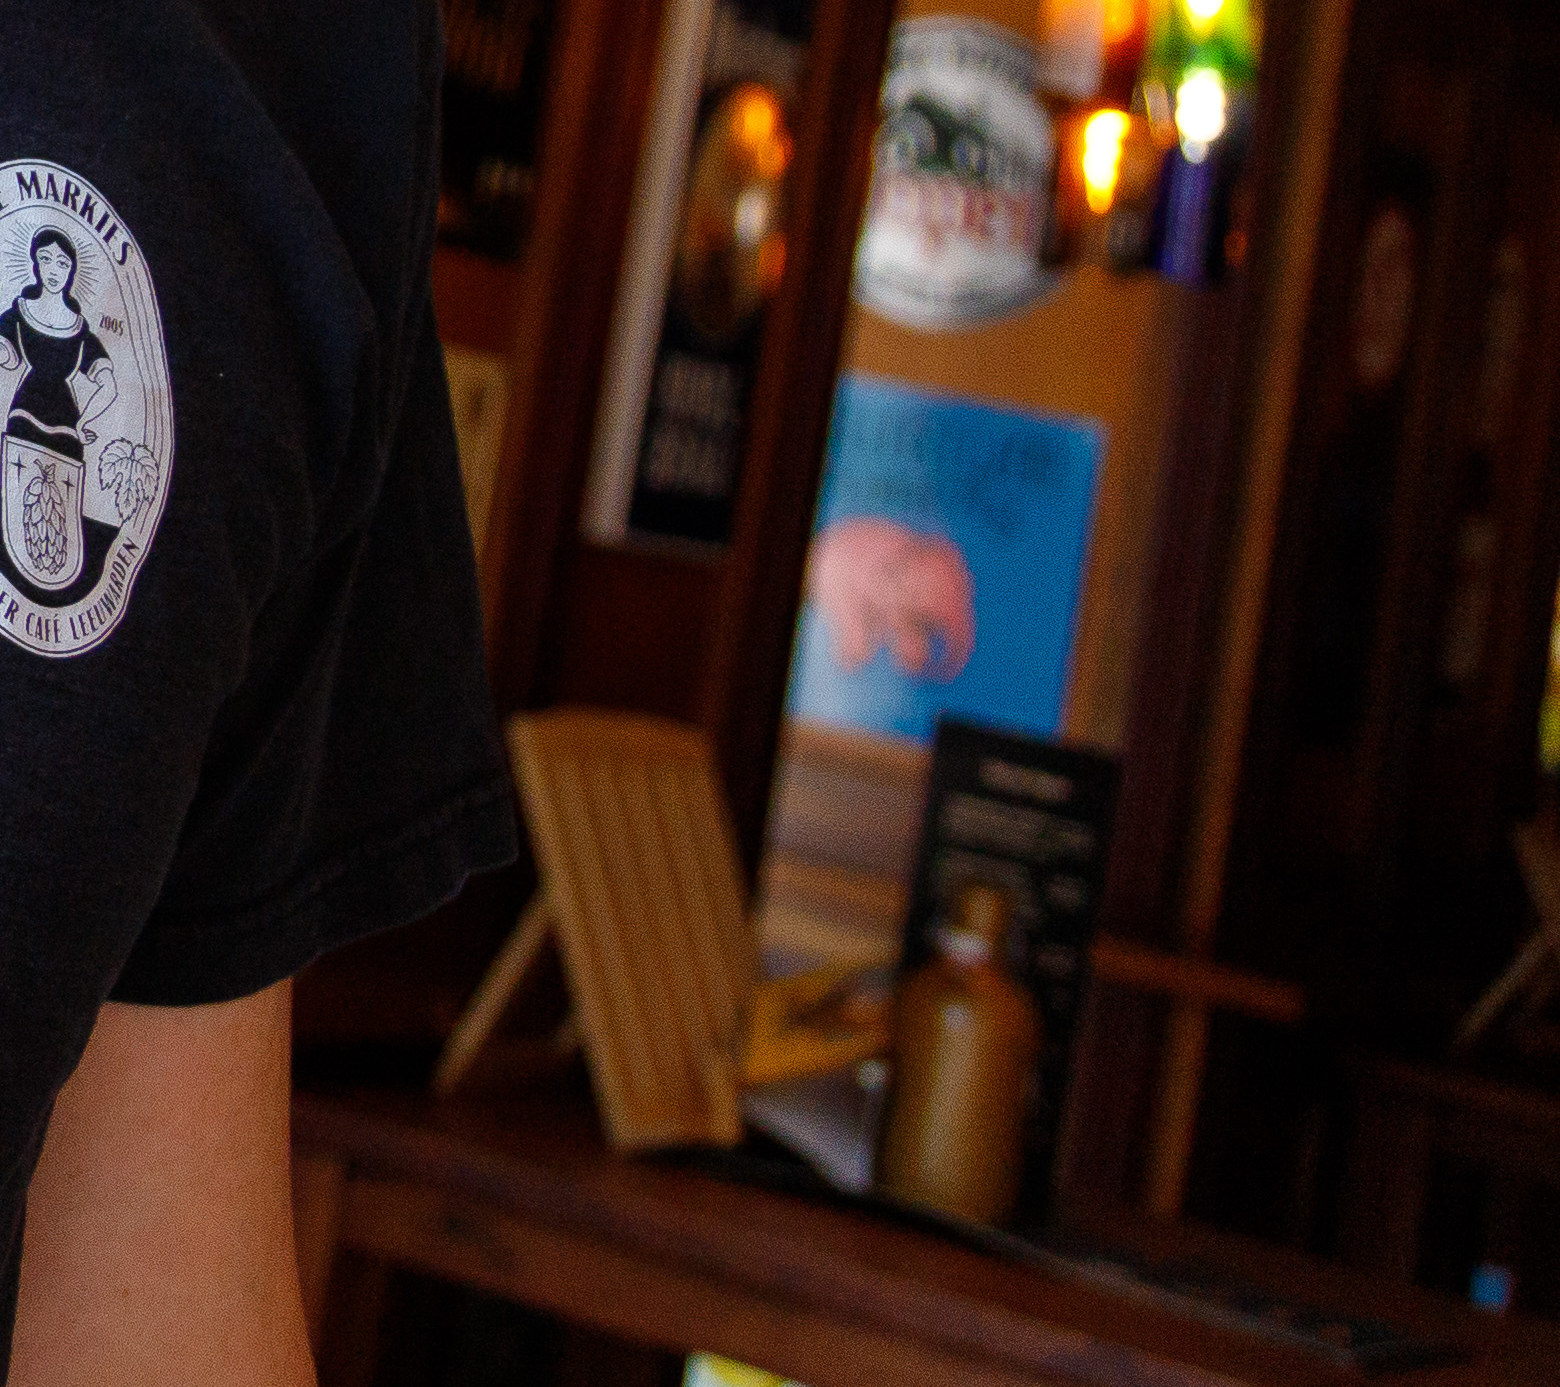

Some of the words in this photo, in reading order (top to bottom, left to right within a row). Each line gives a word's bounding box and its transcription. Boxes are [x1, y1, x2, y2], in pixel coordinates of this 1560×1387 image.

[15, 169, 135, 266] MARKIES
[98, 312, 125, 337] 2005
[25, 612, 62, 644] CAFÉ
[68, 536, 141, 641] LEEUWARDEN
